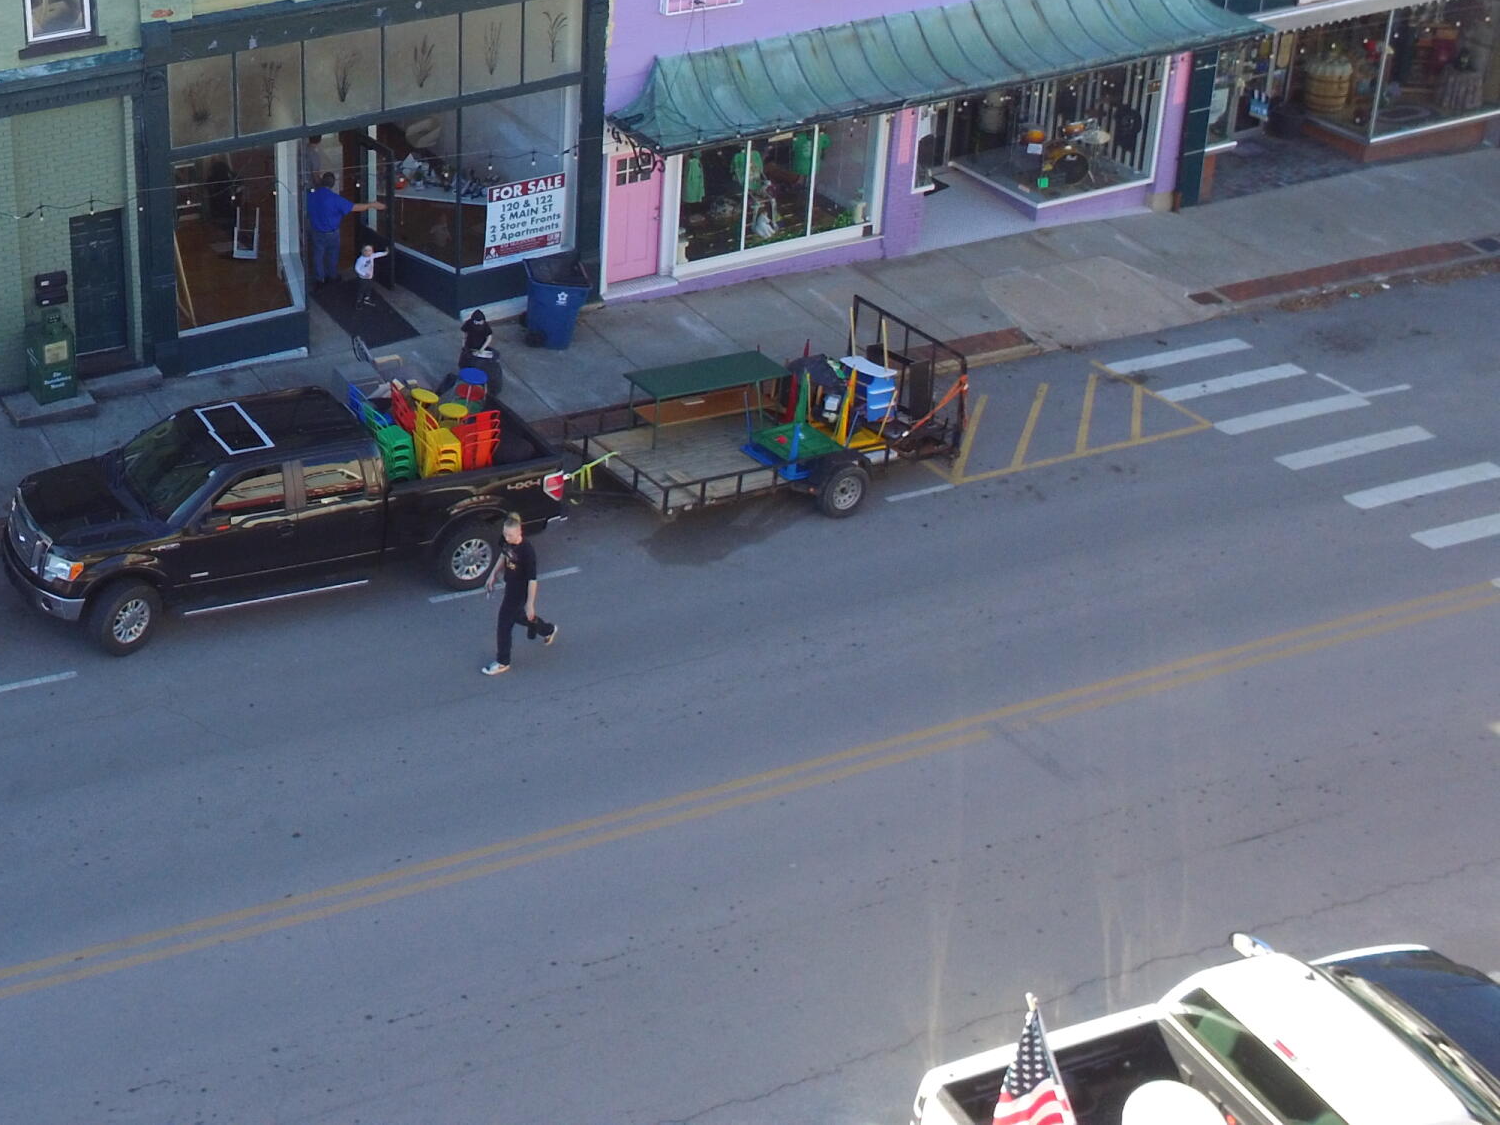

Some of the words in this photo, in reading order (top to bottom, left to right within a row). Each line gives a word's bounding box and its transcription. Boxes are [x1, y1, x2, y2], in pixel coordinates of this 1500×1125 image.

[492, 184, 523, 201] FOR
[527, 175, 562, 194] SALE
[500, 213, 506, 222] S
[509, 207, 539, 220] MAIN
[542, 203, 553, 213] ST
[502, 201, 520, 212] 120
[523, 199, 530, 208] &
[536, 194, 553, 205] 122
[490, 225, 497, 234] 2
[500, 220, 527, 231] Store
[530, 213, 561, 225] Fronts
[490, 235, 496, 243] 3
[500, 222, 559, 241] Apartments
